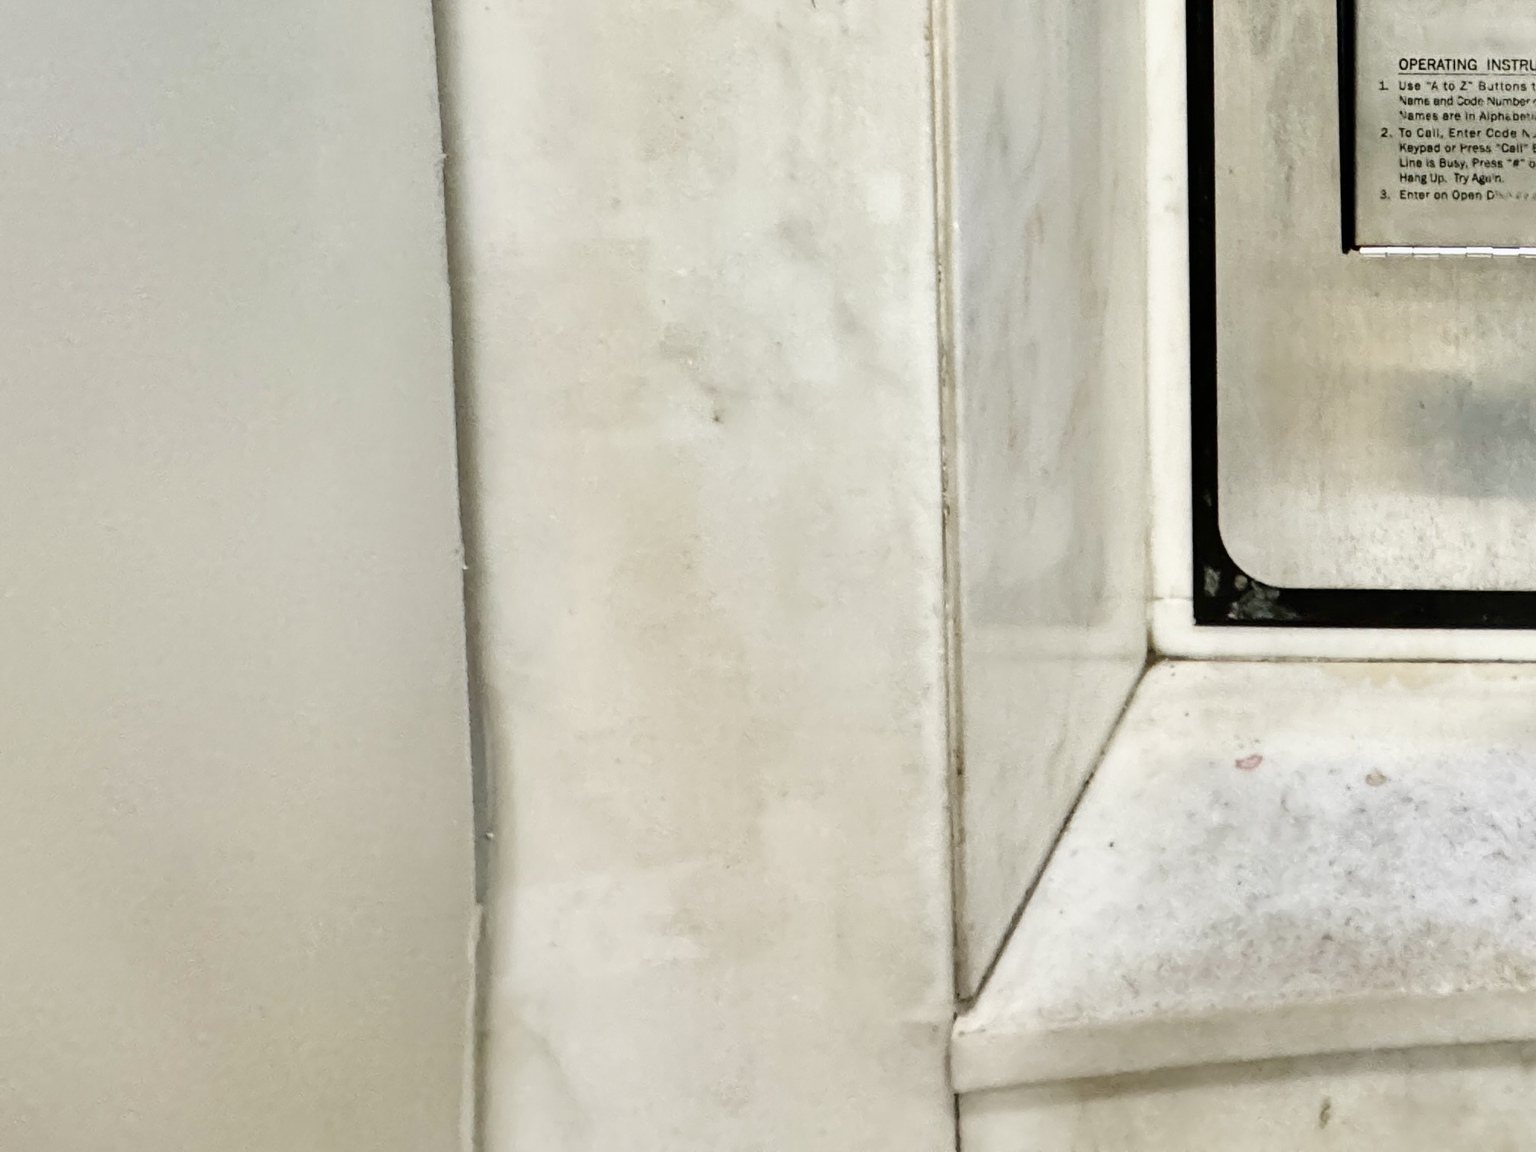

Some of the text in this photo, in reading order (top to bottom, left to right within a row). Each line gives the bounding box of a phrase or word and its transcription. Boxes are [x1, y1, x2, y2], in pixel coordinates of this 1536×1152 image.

[1399, 58, 1478, 72] OPERATING
[1399, 80, 1421, 91] Use
[1443, 81, 1455, 91] to
[1478, 81, 1528, 91] Buttons
[1399, 95, 1430, 106] Name
[1433, 95, 1453, 106] and
[1457, 96, 1484, 106] Code
[1487, 97, 1530, 107] Number
[1399, 110, 1439, 121] Names
[1442, 112, 1461, 121] are
[1380, 127, 1393, 138] 2.
[1398, 127, 1412, 138] To
[1448, 128, 1481, 138] Enter
[1486, 128, 1517, 138] Code
[1399, 142, 1441, 154] Keypad
[1444, 144, 1456, 153] or
[1460, 143, 1492, 153] Press
[1496, 143, 1529, 153] "Call"
[1399, 157, 1422, 168] Line
[1426, 157, 1436, 168] is
[1472, 158, 1504, 168] Press
[1399, 173, 1427, 185] Hang
[1430, 173, 1448, 184] Up.
[1454, 173, 1469, 185] Try
[1380, 189, 1391, 200] 3.
[1399, 189, 1430, 200] Enter
[1433, 191, 1448, 200] on
[1452, 189, 1482, 201] Open
